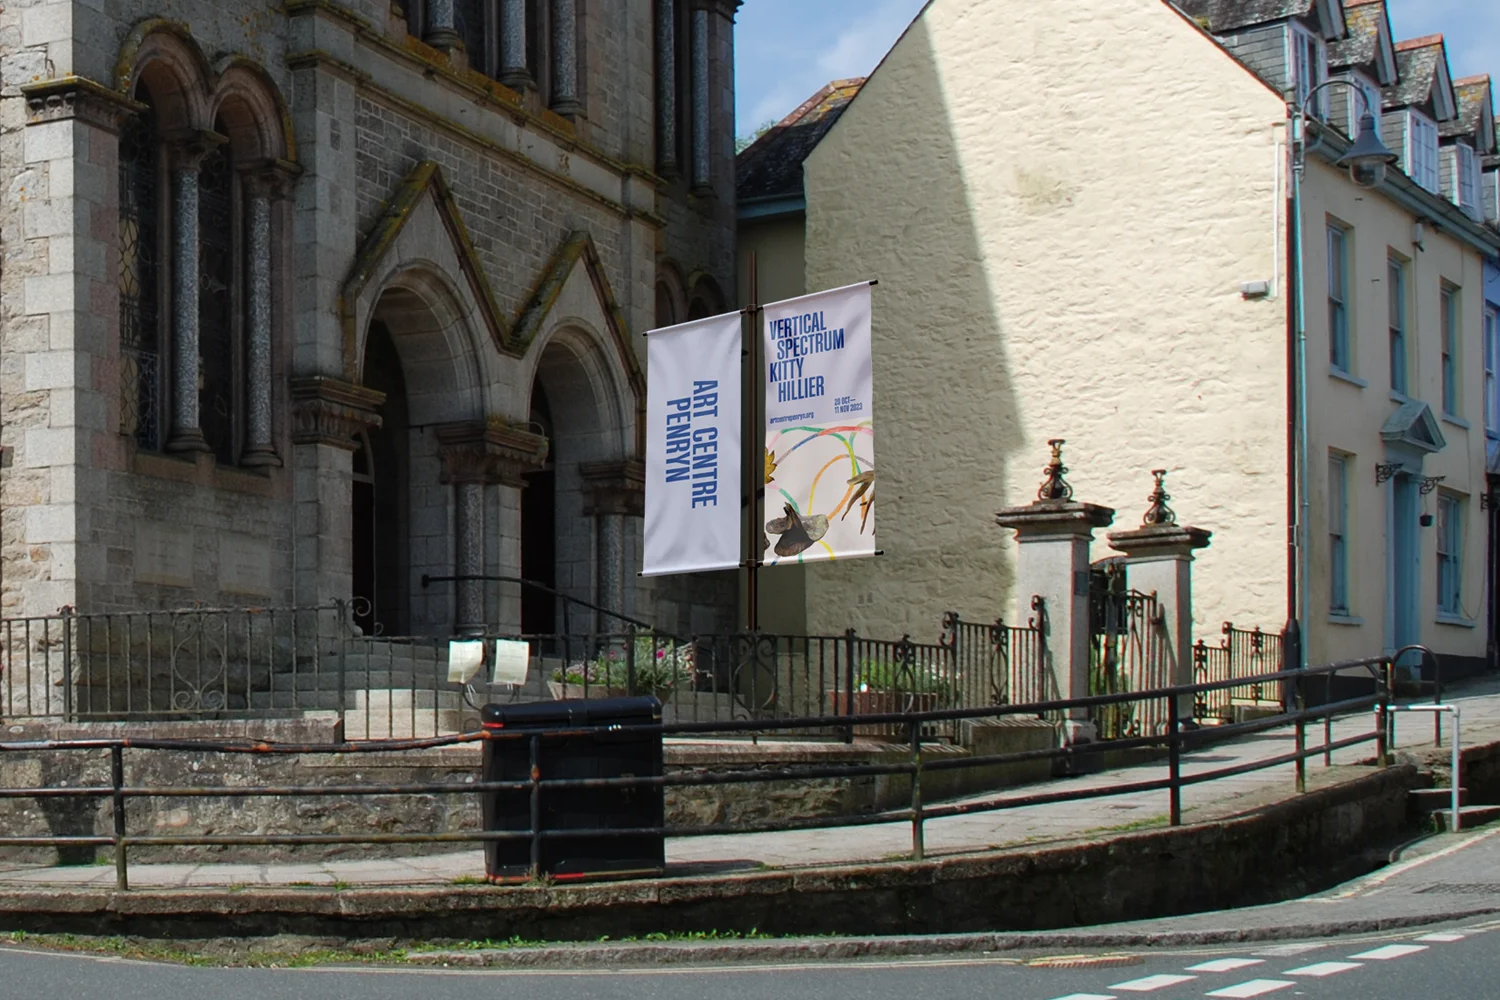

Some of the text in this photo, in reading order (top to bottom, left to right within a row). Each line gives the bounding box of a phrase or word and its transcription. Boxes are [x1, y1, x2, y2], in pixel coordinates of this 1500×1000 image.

[769, 311, 827, 341] VERTICAL
[776, 328, 845, 360] SPECTRUM
[769, 357, 805, 383] KITTY
[777, 375, 825, 402] HILLIER
[834, 402, 863, 414] 11 NOV 2023
[665, 397, 691, 483] PENRYN
[691, 380, 718, 509] ART CENTRE
